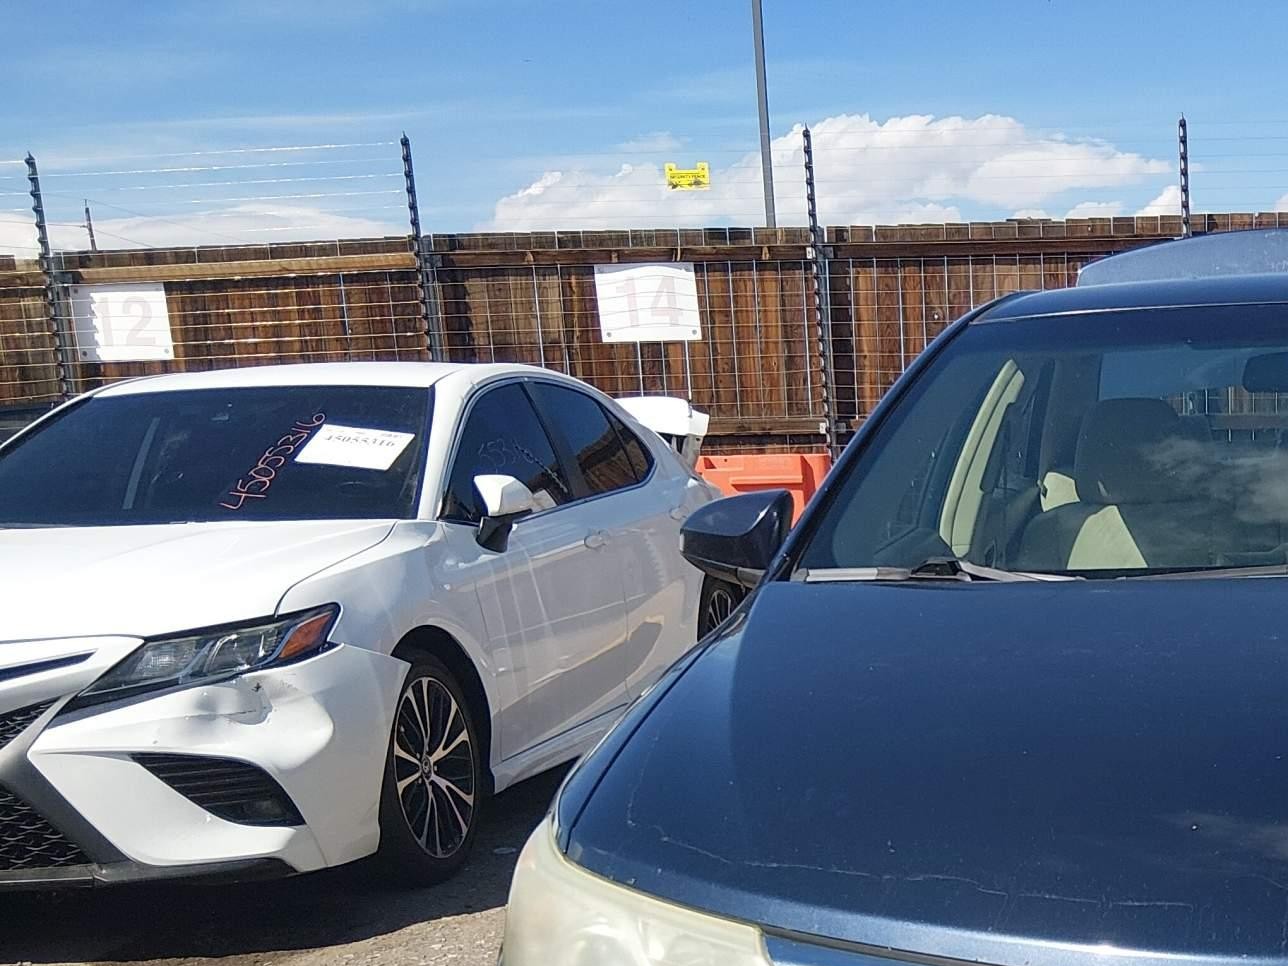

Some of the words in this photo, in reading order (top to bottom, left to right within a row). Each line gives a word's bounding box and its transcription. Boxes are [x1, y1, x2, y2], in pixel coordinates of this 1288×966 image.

[96, 296, 156, 346] 12
[616, 276, 683, 327] 14
[219, 413, 325, 509] 45055316
